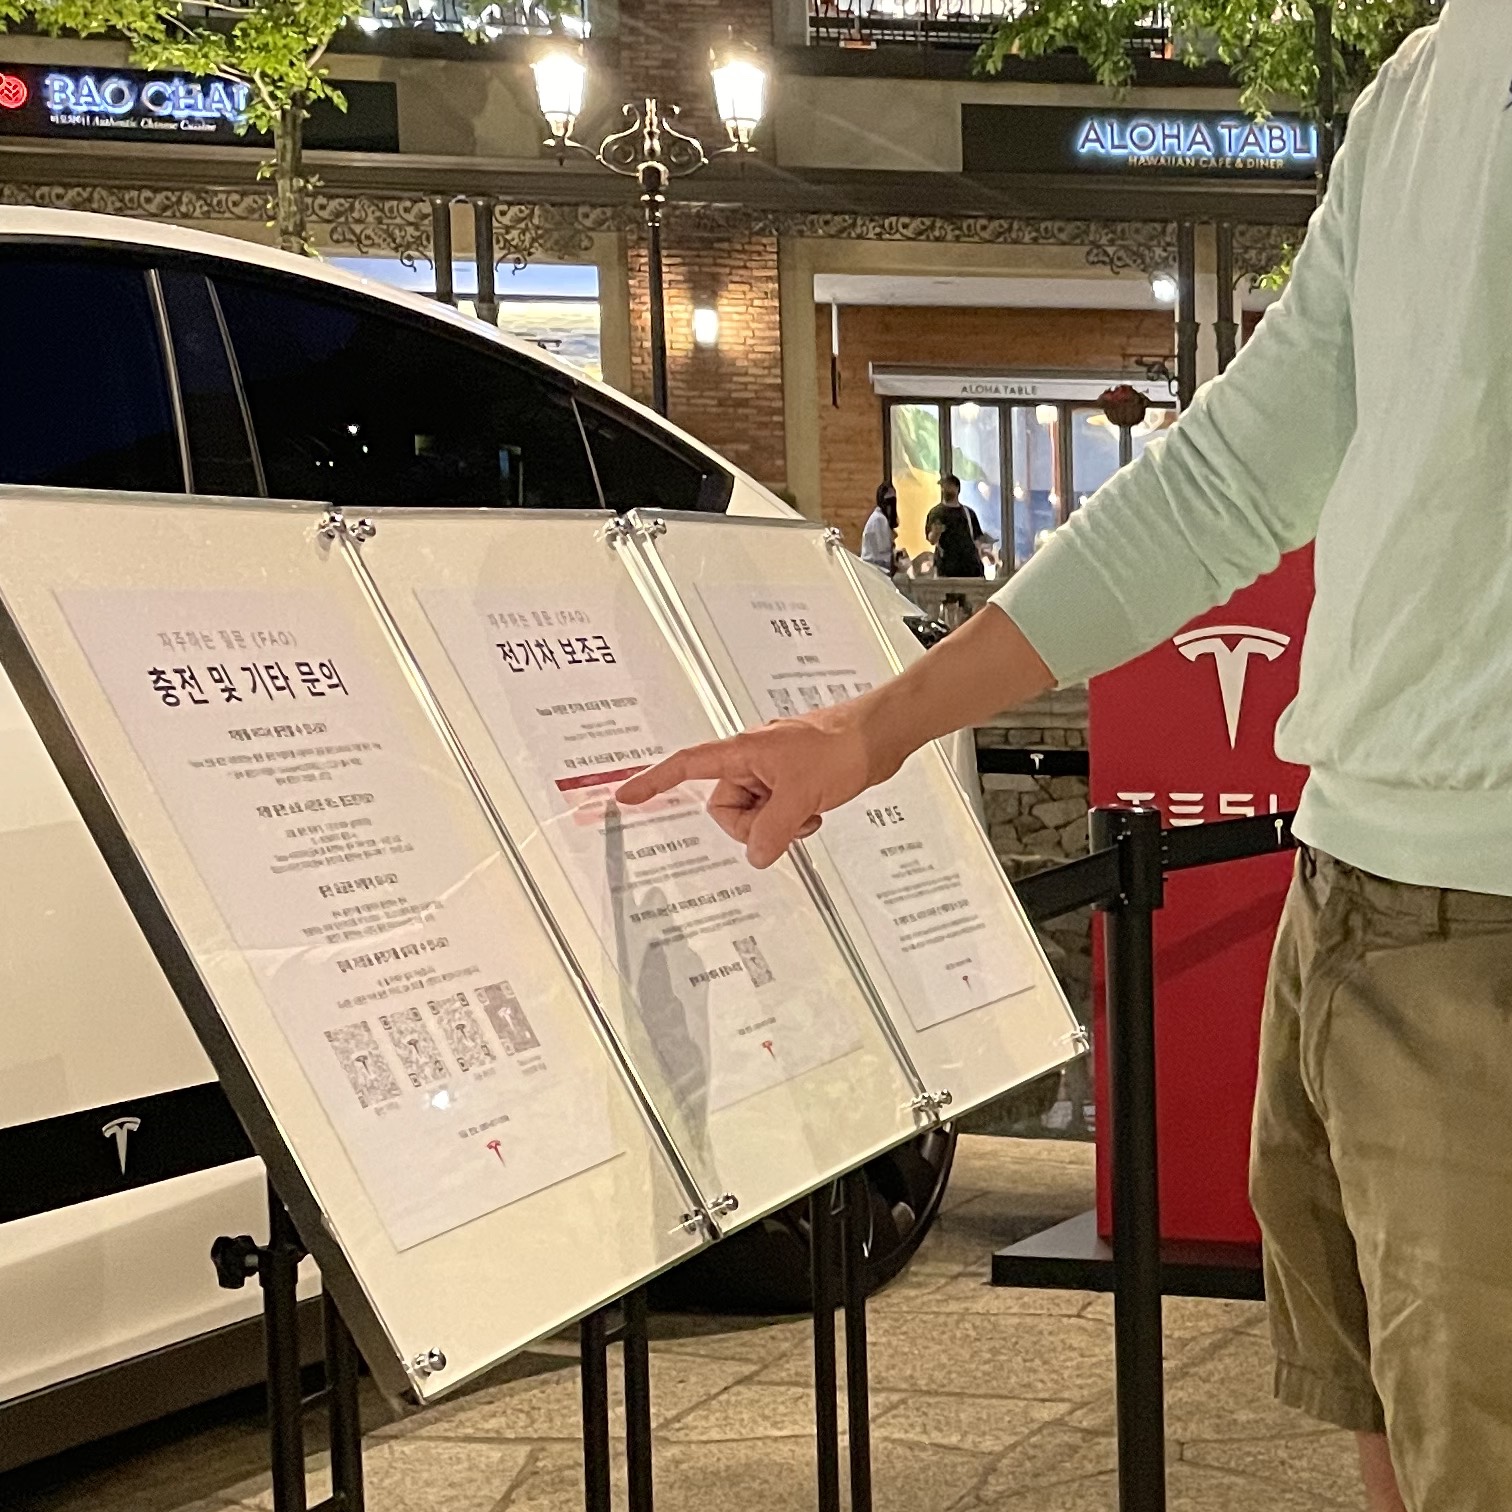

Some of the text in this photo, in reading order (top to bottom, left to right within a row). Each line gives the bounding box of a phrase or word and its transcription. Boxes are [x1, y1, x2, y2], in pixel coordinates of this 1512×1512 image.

[46, 74, 250, 120] BAO CHAI
[1079, 118, 1318, 157] ALOHA TABL
[1128, 155, 1195, 168] HAWAIIAN
[1246, 159, 1285, 170] DINER
[960, 384, 1039, 396] ALOHA TABLE
[251, 630, 298, 649] (FAQ)
[496, 635, 617, 673] 전기차 보조금
[147, 658, 349, 707] 충전 및 기타 문의
